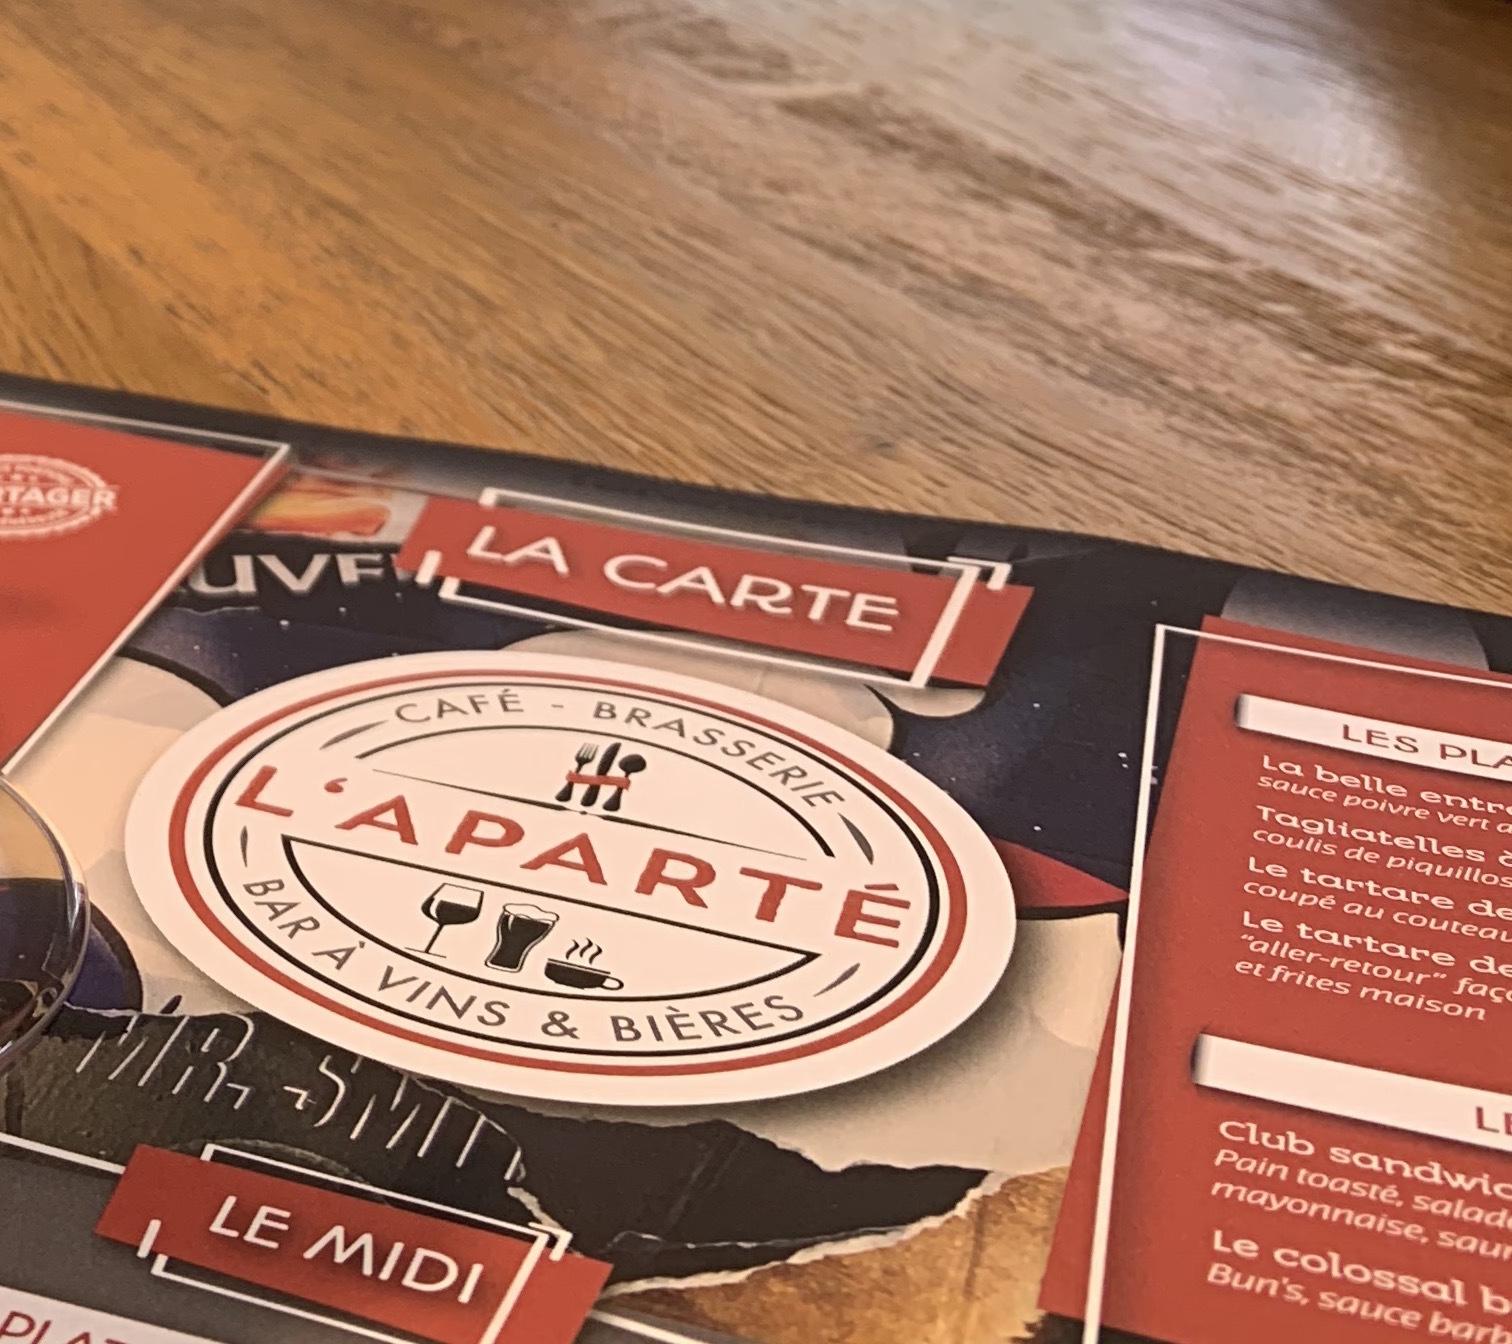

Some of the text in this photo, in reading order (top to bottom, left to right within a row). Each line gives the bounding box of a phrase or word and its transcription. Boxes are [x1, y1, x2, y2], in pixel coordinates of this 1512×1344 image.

[467, 525, 899, 632] LA CARTE
[394, 688, 845, 809] CAFÉ BRASSERIE
[1342, 724, 1419, 754] LES
[1257, 775, 1491, 831] sauce poivre vert
[1263, 755, 1408, 797] La belle
[1253, 829, 1338, 856] coulis
[1344, 845, 1381, 863] de
[1256, 805, 1486, 863] Tagliatelles
[1243, 881, 1337, 910] coupé
[1343, 901, 1385, 920] au
[1248, 857, 1288, 878] Le
[1300, 867, 1455, 910] tartare
[242, 879, 805, 1043] BAR À VINS & BIÈRES
[1242, 911, 1284, 934] Le
[1296, 922, 1456, 967] tartare
[1235, 960, 1487, 1021] et frites maison
[1219, 1121, 1315, 1156] Club
[1214, 1149, 1404, 1208] Pain toasté,
[1210, 1181, 1429, 1244] mayonnaise,
[208, 1195, 484, 1305] LE MIDI
[1213, 1229, 1468, 1307] Le colossal
[1207, 1262, 1421, 1328] Bun's, sauce
